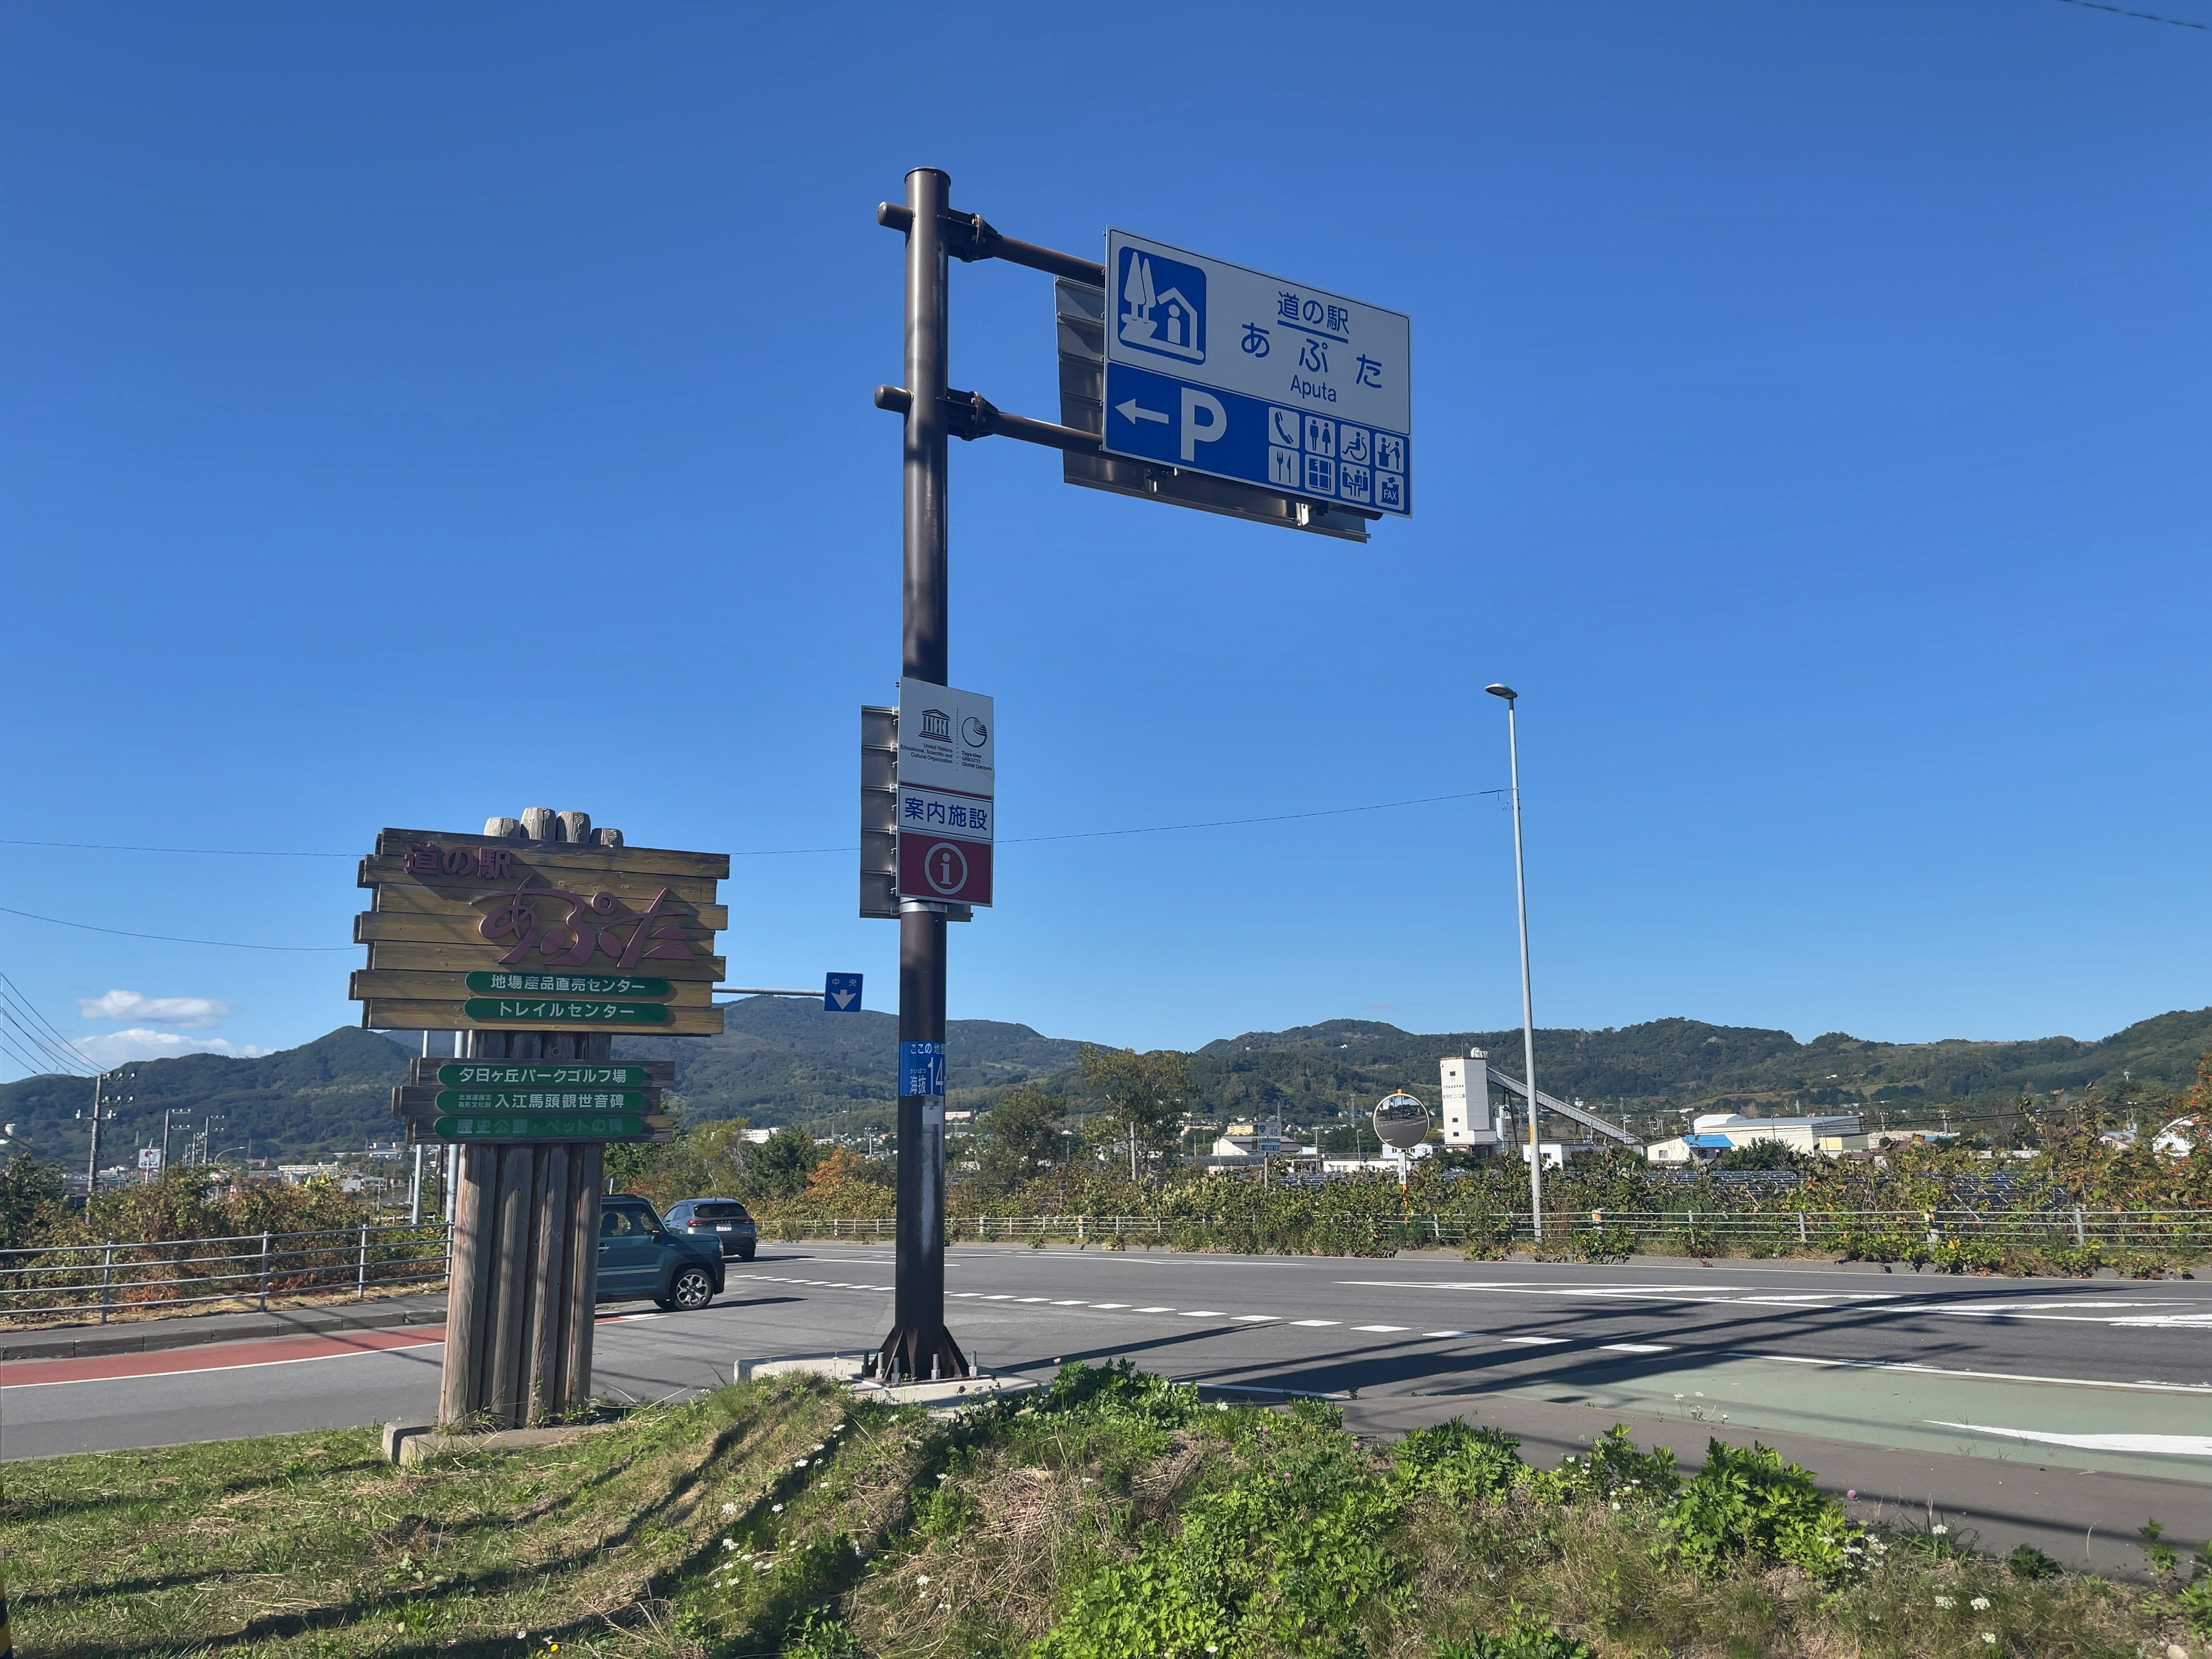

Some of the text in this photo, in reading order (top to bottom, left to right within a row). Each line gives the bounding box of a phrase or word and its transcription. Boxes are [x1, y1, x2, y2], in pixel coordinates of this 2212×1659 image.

[1277, 291, 1349, 334] 道の駅
[1241, 322, 1382, 388] あぷた
[1290, 374, 1336, 403] Aputa
[1181, 387, 1227, 462] P
[1384, 489, 1397, 501] FAX
[923, 715, 949, 736] UNESCO
[927, 755, 953, 764] Organization
[905, 797, 988, 831] 案内施設
[404, 843, 511, 879] 道の駅
[469, 874, 696, 968] あぷた
[491, 974, 645, 993] 地場産品直売センター
[832, 978, 857, 987] 中央
[500, 1001, 634, 1018] トレイルセンター
[910, 1057, 944, 1094] 海抜 14
[494, 1093, 624, 1108] 入江馬頭観世音碑
